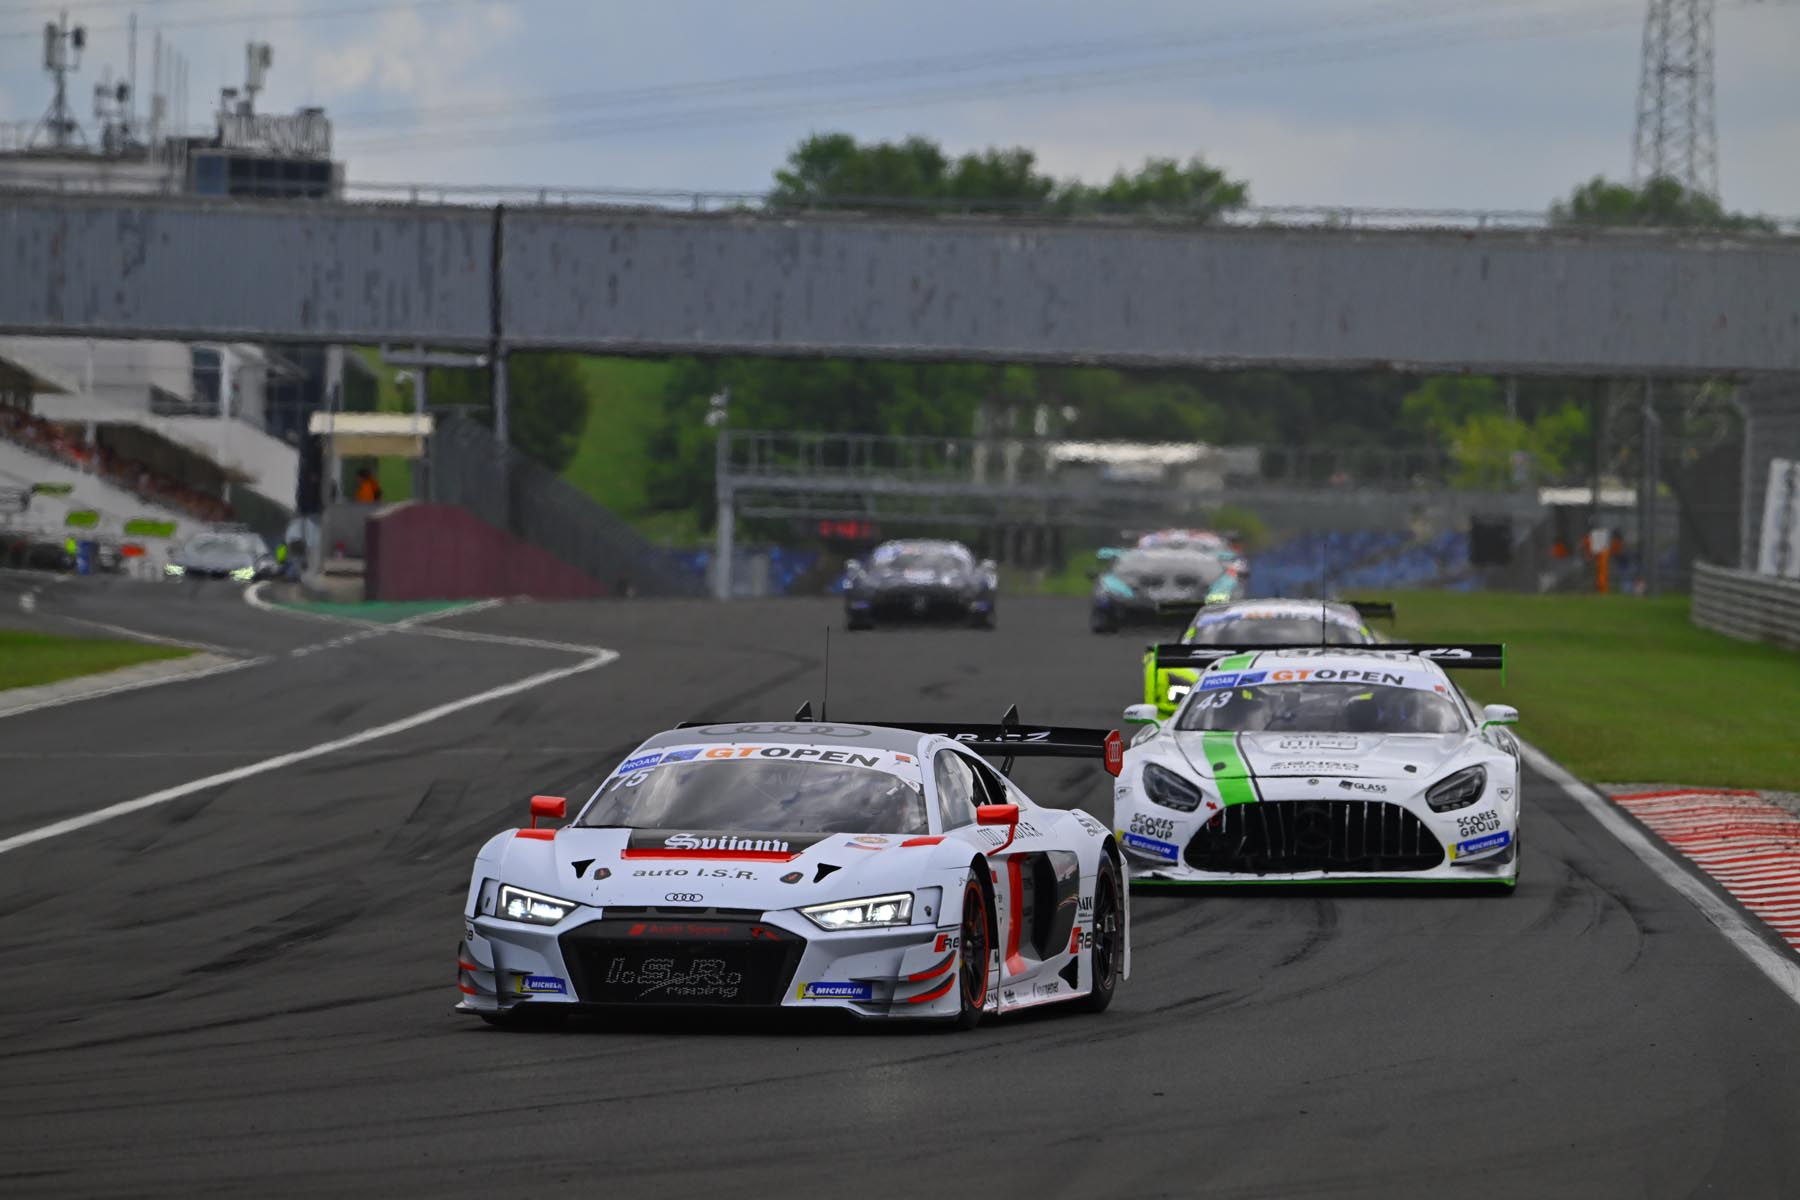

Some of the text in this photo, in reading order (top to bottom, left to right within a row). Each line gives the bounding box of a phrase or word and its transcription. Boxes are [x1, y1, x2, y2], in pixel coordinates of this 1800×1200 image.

[1197, 691, 1233, 710] 43
[621, 756, 660, 771] PROAM
[1354, 782, 1387, 792] GLASS
[1131, 813, 1174, 829] SCORES
[1456, 810, 1497, 827] SCORES
[1130, 824, 1172, 840] GROUP
[1460, 820, 1501, 837] GROUP
[632, 869, 758, 881] auto I.S.R.
[606, 957, 742, 984] I.S.R.
[815, 986, 864, 995] MICHELIN
